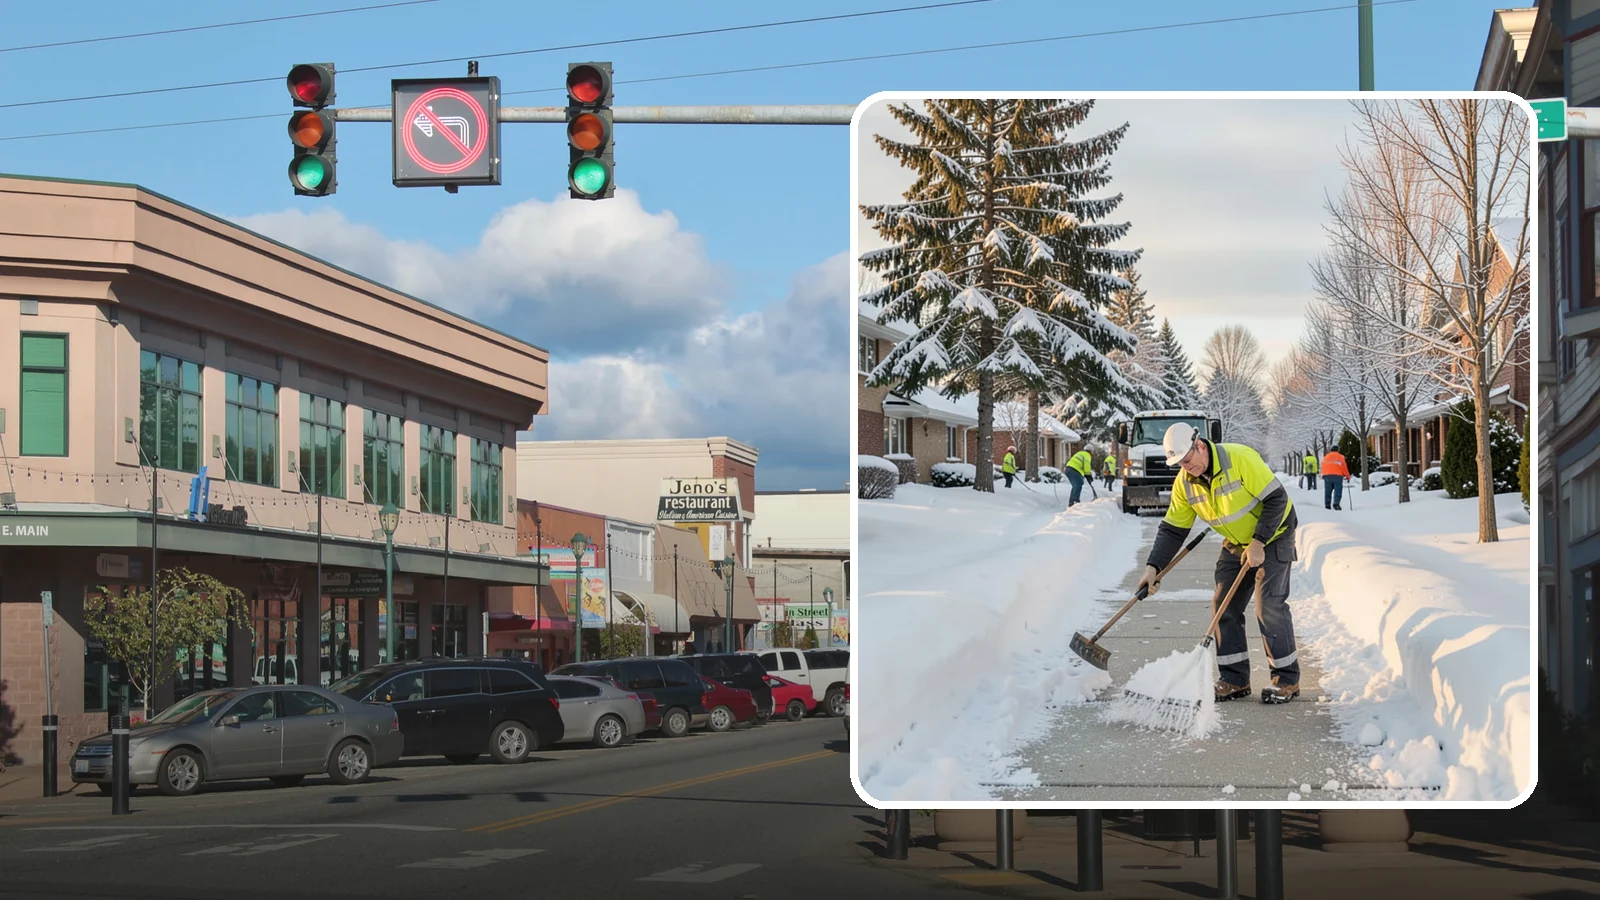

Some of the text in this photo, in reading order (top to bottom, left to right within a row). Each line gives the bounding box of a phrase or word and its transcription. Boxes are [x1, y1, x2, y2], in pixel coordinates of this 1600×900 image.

[670, 480, 727, 494] Jeno's
[665, 497, 731, 509] restaurant
[659, 510, 681, 519] Italian
[686, 510, 714, 519] American
[715, 510, 737, 519] Cuisine
[2, 525, 49, 536] E. MAIN
[797, 608, 828, 617] Street
